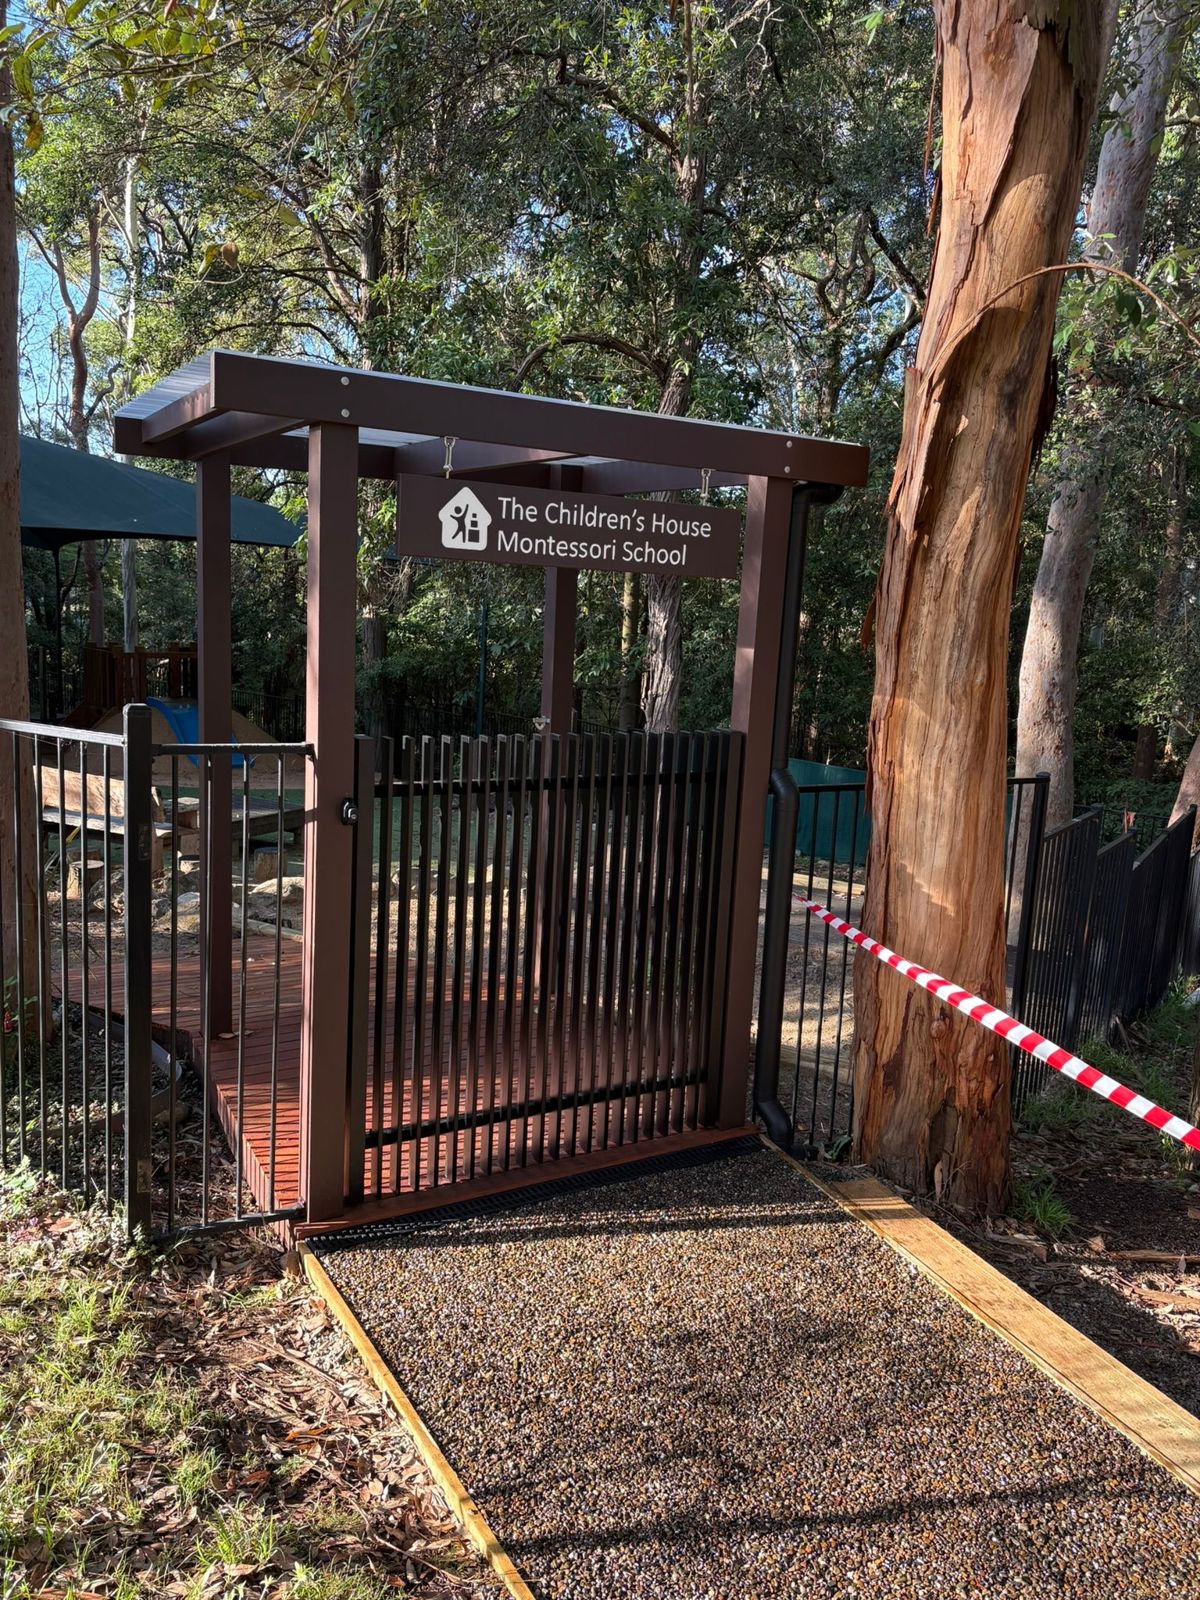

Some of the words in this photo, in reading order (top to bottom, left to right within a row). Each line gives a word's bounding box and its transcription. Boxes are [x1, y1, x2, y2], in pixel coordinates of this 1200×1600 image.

[498, 496, 538, 523] The
[544, 501, 645, 533] Children's
[652, 513, 712, 538] House
[497, 530, 617, 561] Montessori
[622, 541, 687, 566] School
